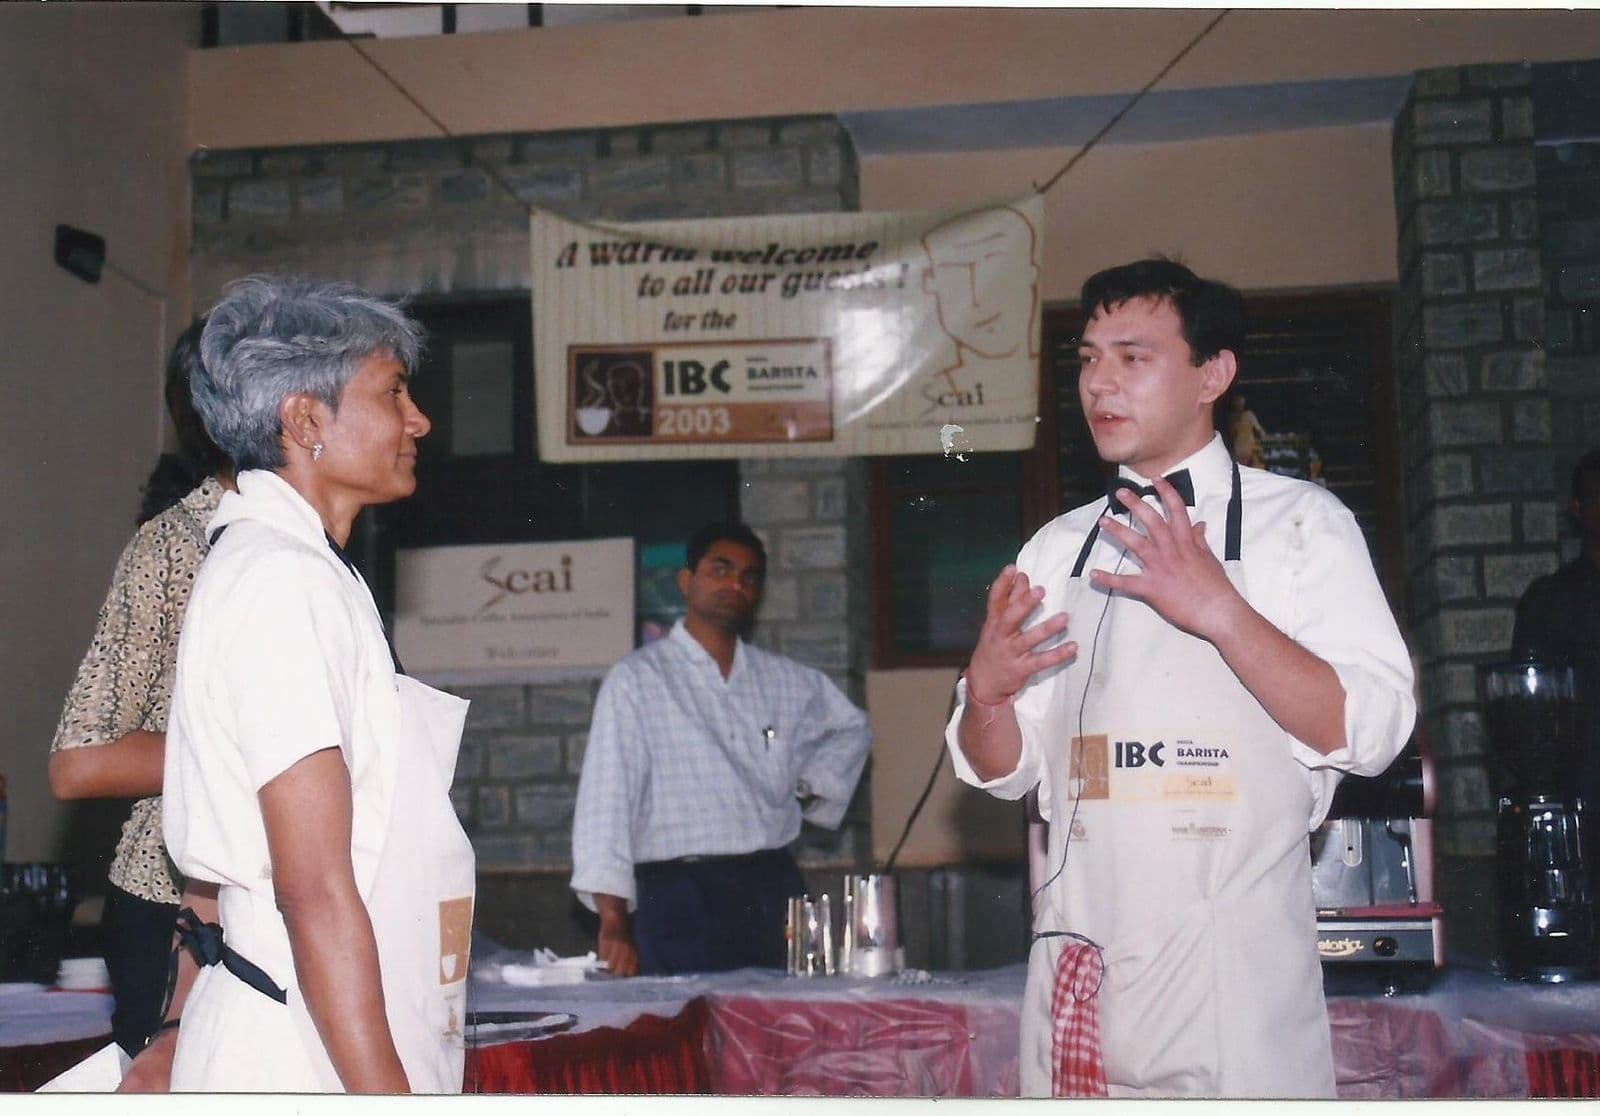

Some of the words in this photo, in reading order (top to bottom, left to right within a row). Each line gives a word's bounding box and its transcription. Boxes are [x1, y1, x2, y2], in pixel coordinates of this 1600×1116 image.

[711, 241, 879, 265] welcome
[638, 272, 665, 298] to
[672, 267, 714, 296] all
[720, 271, 776, 294] our
[781, 264, 888, 299] gue
[663, 310, 696, 332] for
[701, 308, 738, 331] the
[663, 359, 731, 396] IBC
[657, 407, 732, 435] 2003
[1115, 740, 1166, 769] IBC
[1176, 748, 1230, 759] BARISTA
